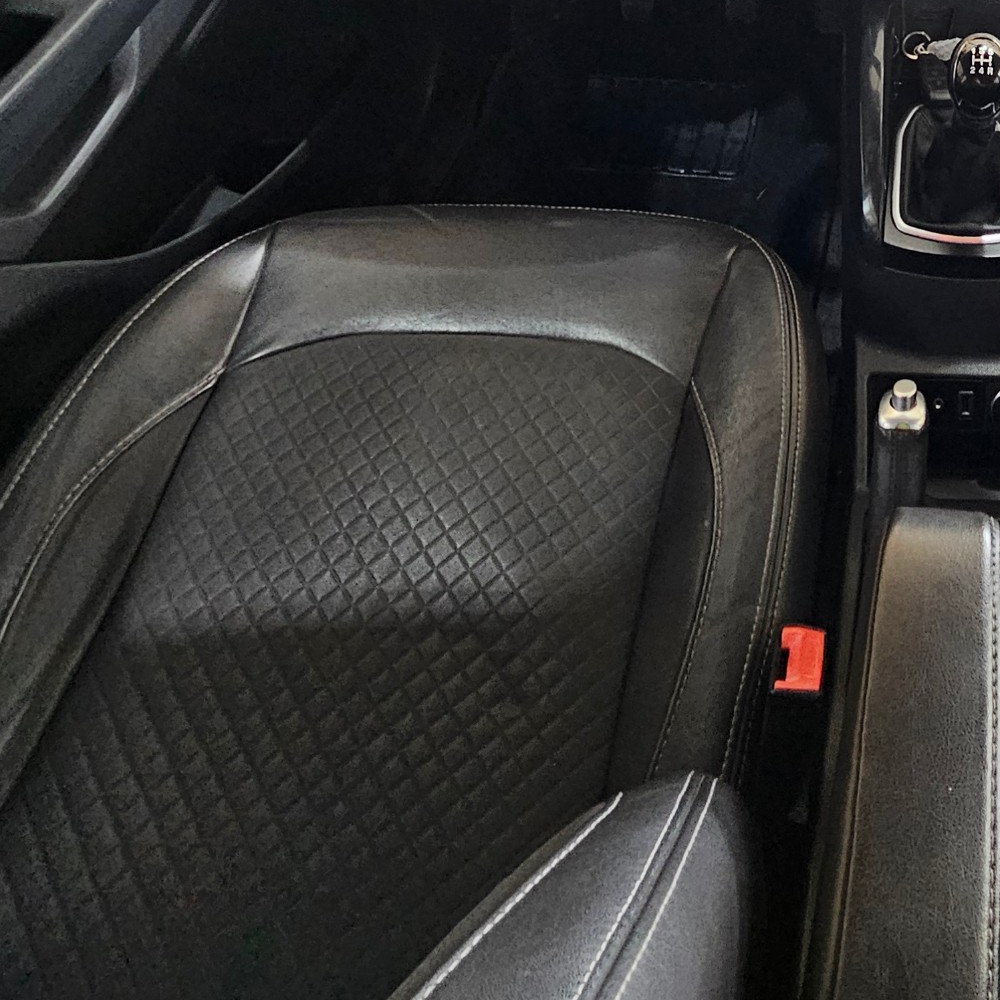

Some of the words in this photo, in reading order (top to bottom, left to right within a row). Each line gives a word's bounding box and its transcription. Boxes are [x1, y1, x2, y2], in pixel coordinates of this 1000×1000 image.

[969, 66, 976, 75] 2
[978, 66, 985, 75] 4
[986, 66, 994, 76] R
